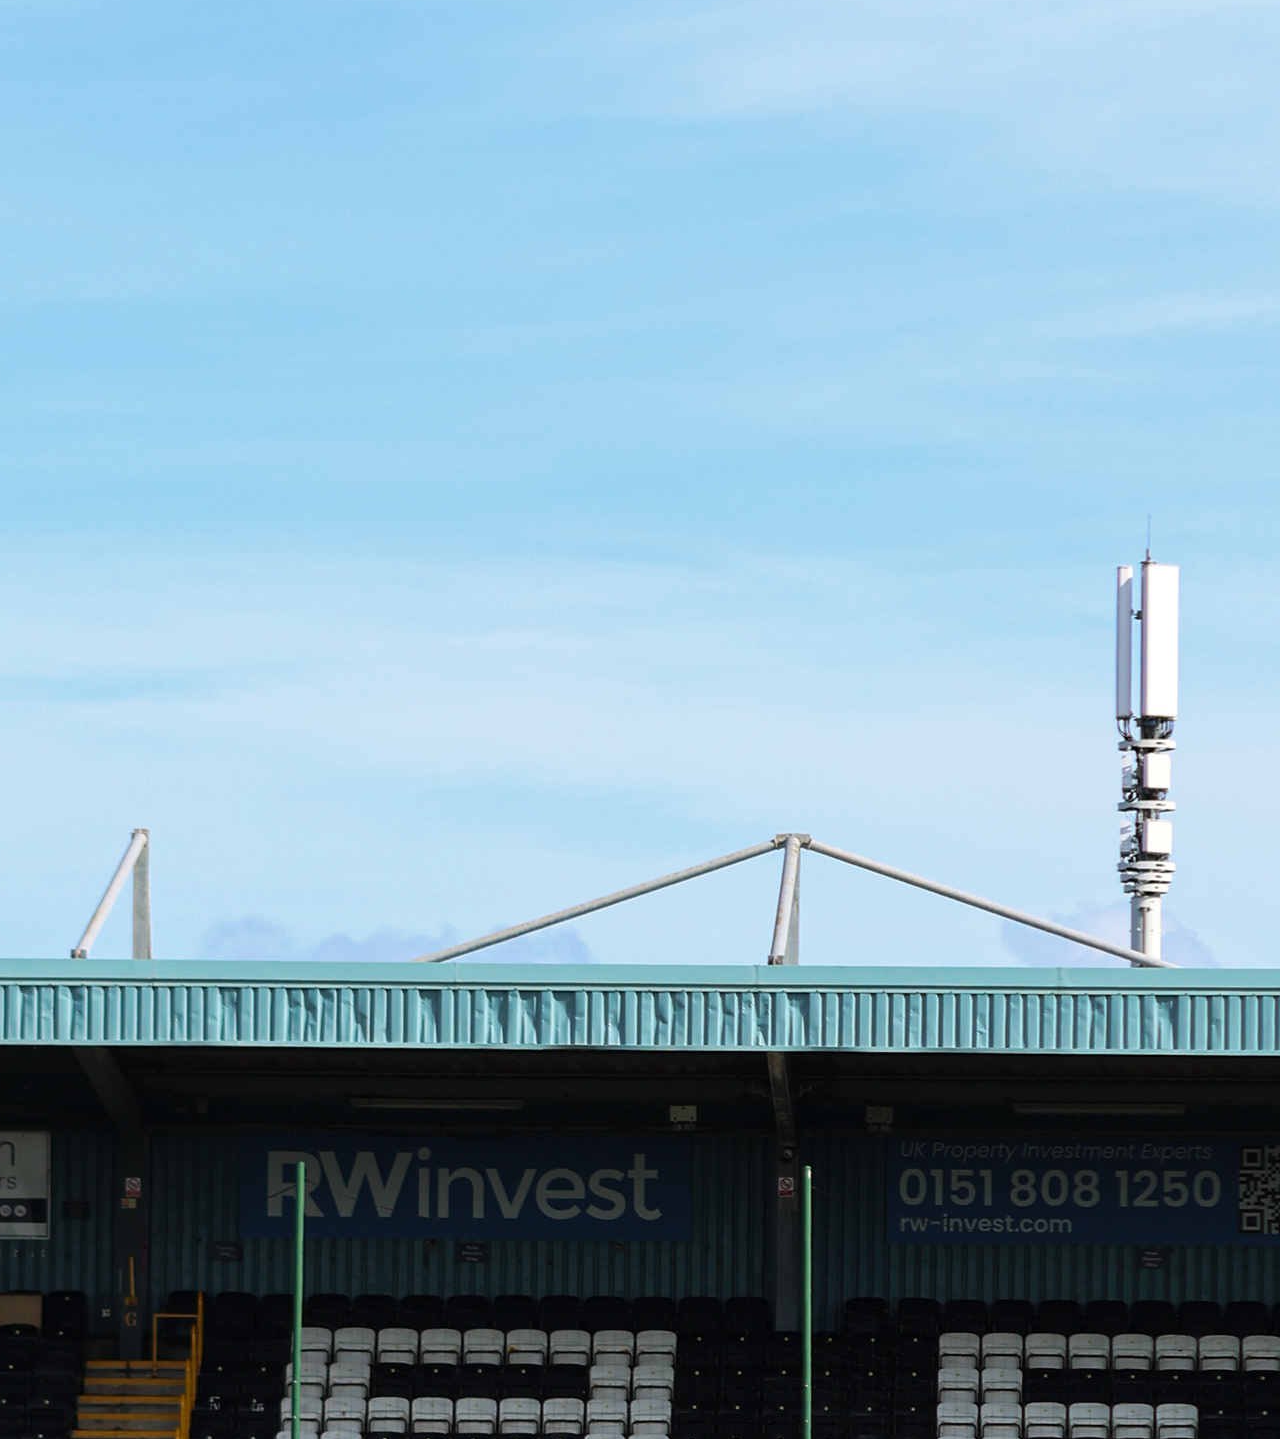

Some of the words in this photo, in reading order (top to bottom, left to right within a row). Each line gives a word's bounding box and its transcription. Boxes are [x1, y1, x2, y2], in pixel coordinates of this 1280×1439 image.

[900, 1141, 926, 1158] UK
[930, 1141, 1017, 1163] Property
[1022, 1142, 1138, 1160] Investment
[1141, 1144, 1212, 1164] Experts
[267, 1146, 663, 1221] RWinvest
[899, 1168, 994, 1207] 0151
[1010, 1169, 1102, 1208] 808
[1115, 1170, 1222, 1209] 1250
[900, 1213, 1073, 1234] rw-invest.com
